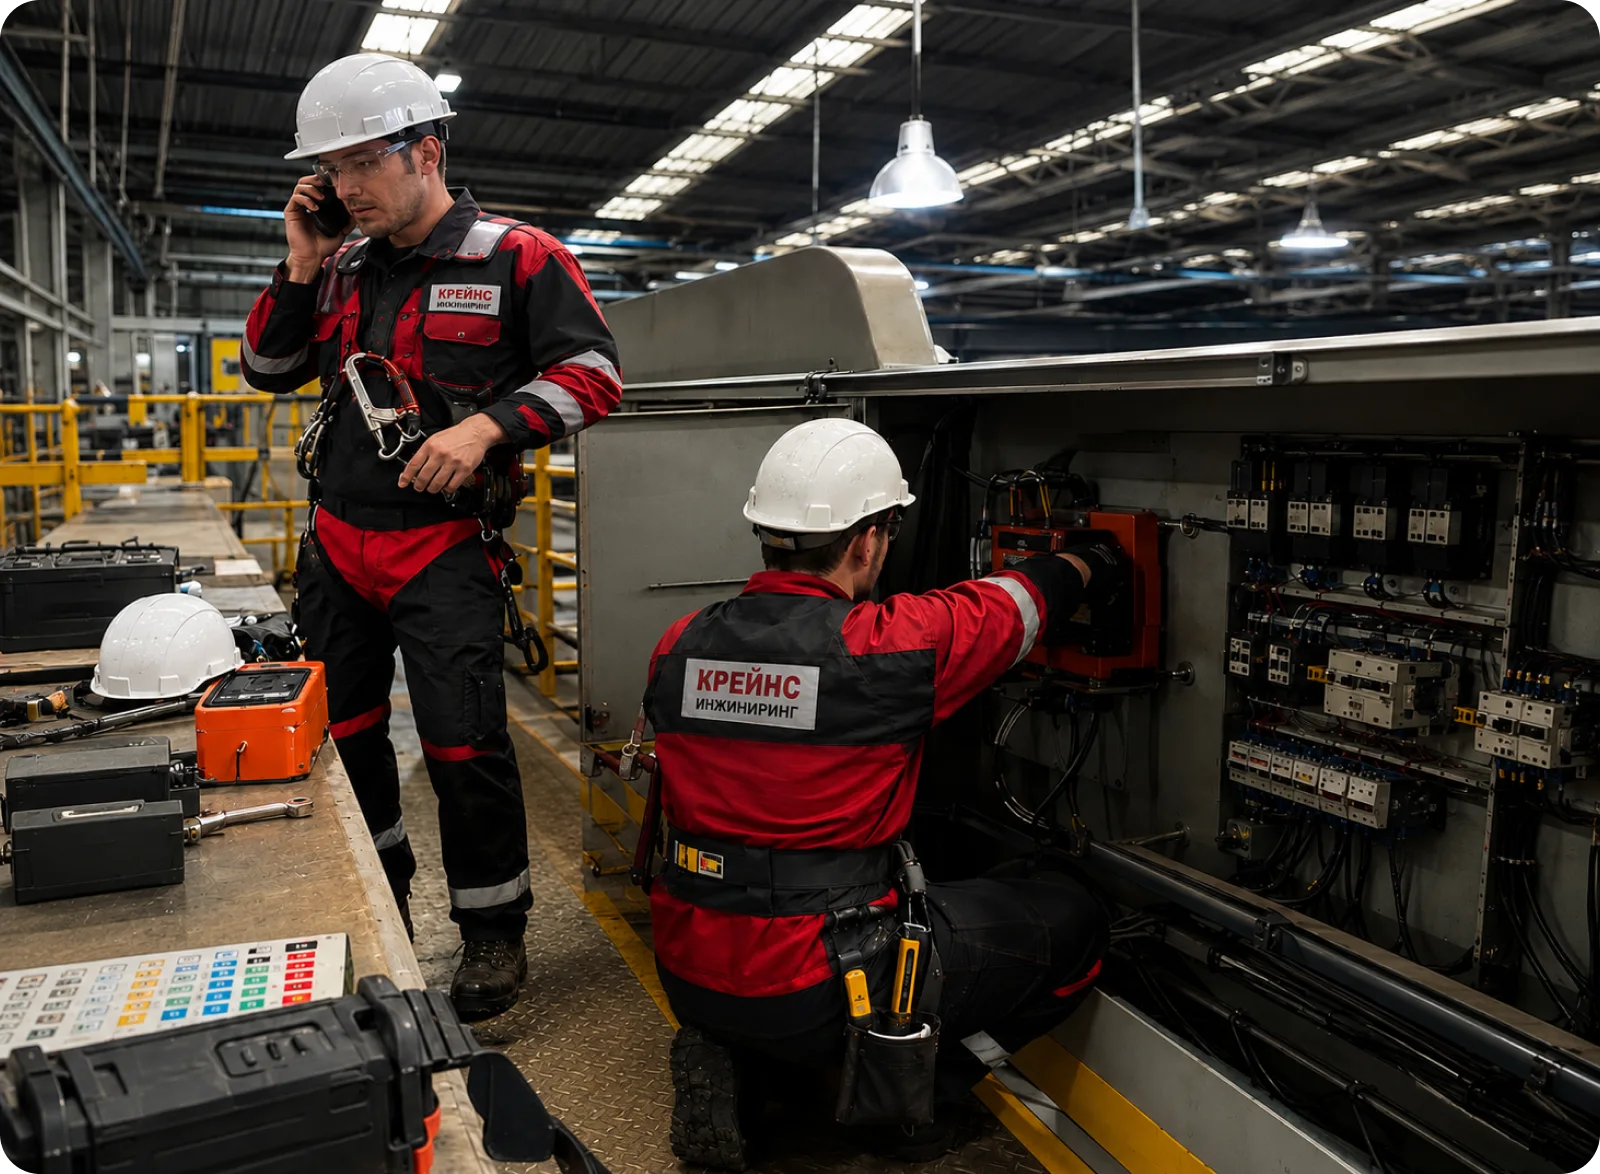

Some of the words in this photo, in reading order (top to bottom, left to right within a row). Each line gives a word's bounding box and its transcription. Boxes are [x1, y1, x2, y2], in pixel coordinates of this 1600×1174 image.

[438, 286, 493, 301] КРЕЙНС
[696, 666, 801, 700] КРЕЙНС
[695, 698, 799, 719] ИНЖИНИРИНГ
